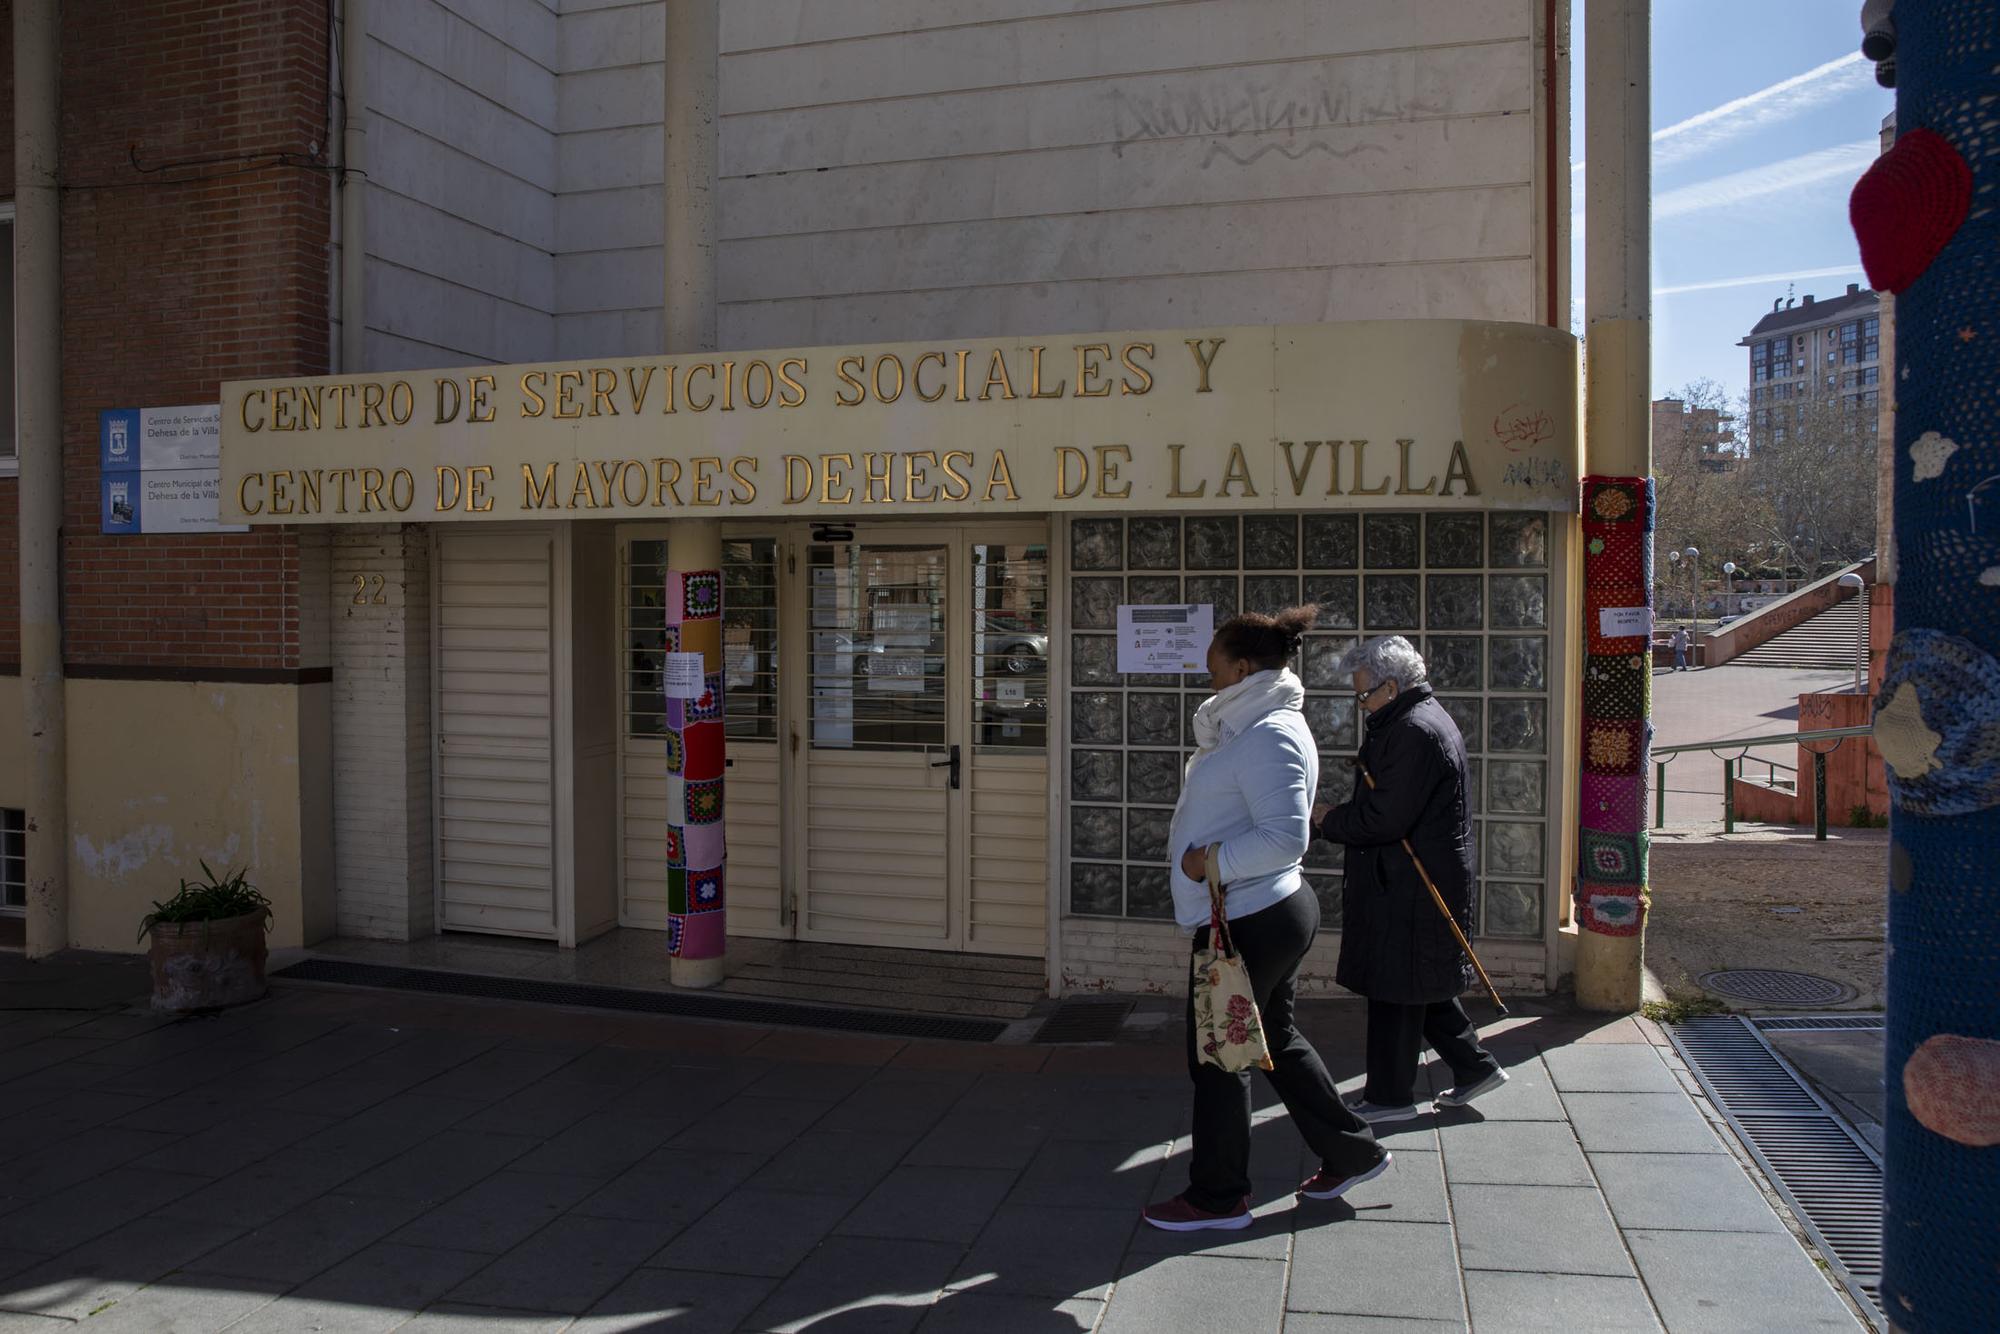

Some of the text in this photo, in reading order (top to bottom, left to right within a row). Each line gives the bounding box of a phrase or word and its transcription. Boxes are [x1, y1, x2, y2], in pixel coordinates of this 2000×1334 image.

[241, 338, 1226, 432] CENTRO DE SERVICIOS SOCIALES Y
[148, 417, 172, 426] Centro
[173, 416, 182, 425] de
[183, 415, 212, 424] Servicios
[148, 426, 218, 437] Dehesa de la Villa
[236, 465, 414, 515] CENTRO
[434, 465, 495, 512] DE
[520, 456, 759, 509] MAYORES
[781, 448, 1022, 504] DEHESA
[1054, 444, 1133, 499] DE
[1167, 442, 1261, 498] LA
[1279, 439, 1482, 497] VILLA
[148, 480, 171, 488] Centro
[173, 479, 202, 489] Municipal
[203, 479, 212, 487] de
[148, 490, 219, 500] Dehesa de la Villa
[352, 574, 387, 604] 22
